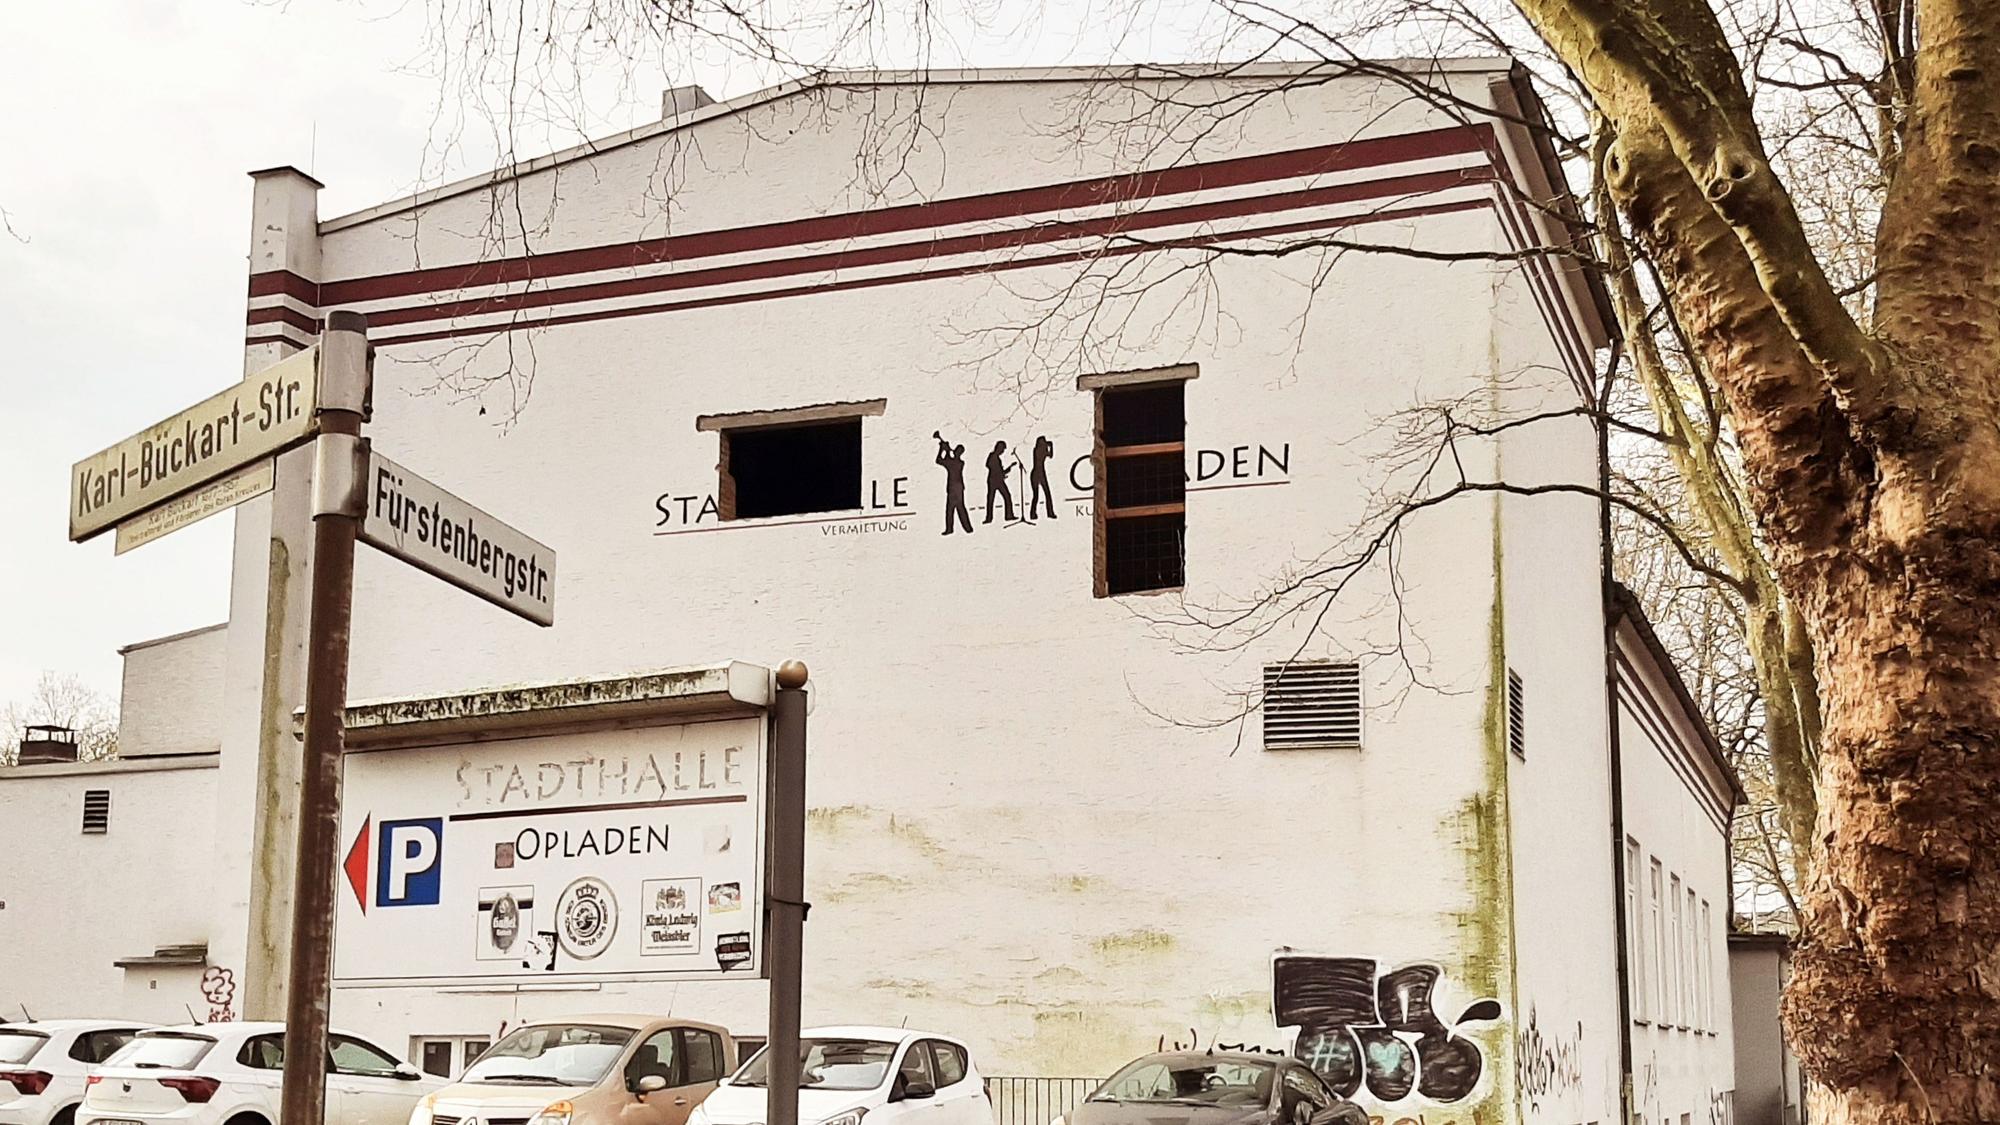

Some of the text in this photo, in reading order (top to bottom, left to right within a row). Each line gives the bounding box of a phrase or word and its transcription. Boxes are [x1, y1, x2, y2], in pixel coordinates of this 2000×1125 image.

[77, 376, 300, 517] Karl-Bückart-Str.
[374, 467, 548, 604] Fürstenbergstr.
[821, 520, 908, 536] VERMIETUNG
[456, 746, 744, 806] STADTHALLE
[388, 825, 438, 900] P
